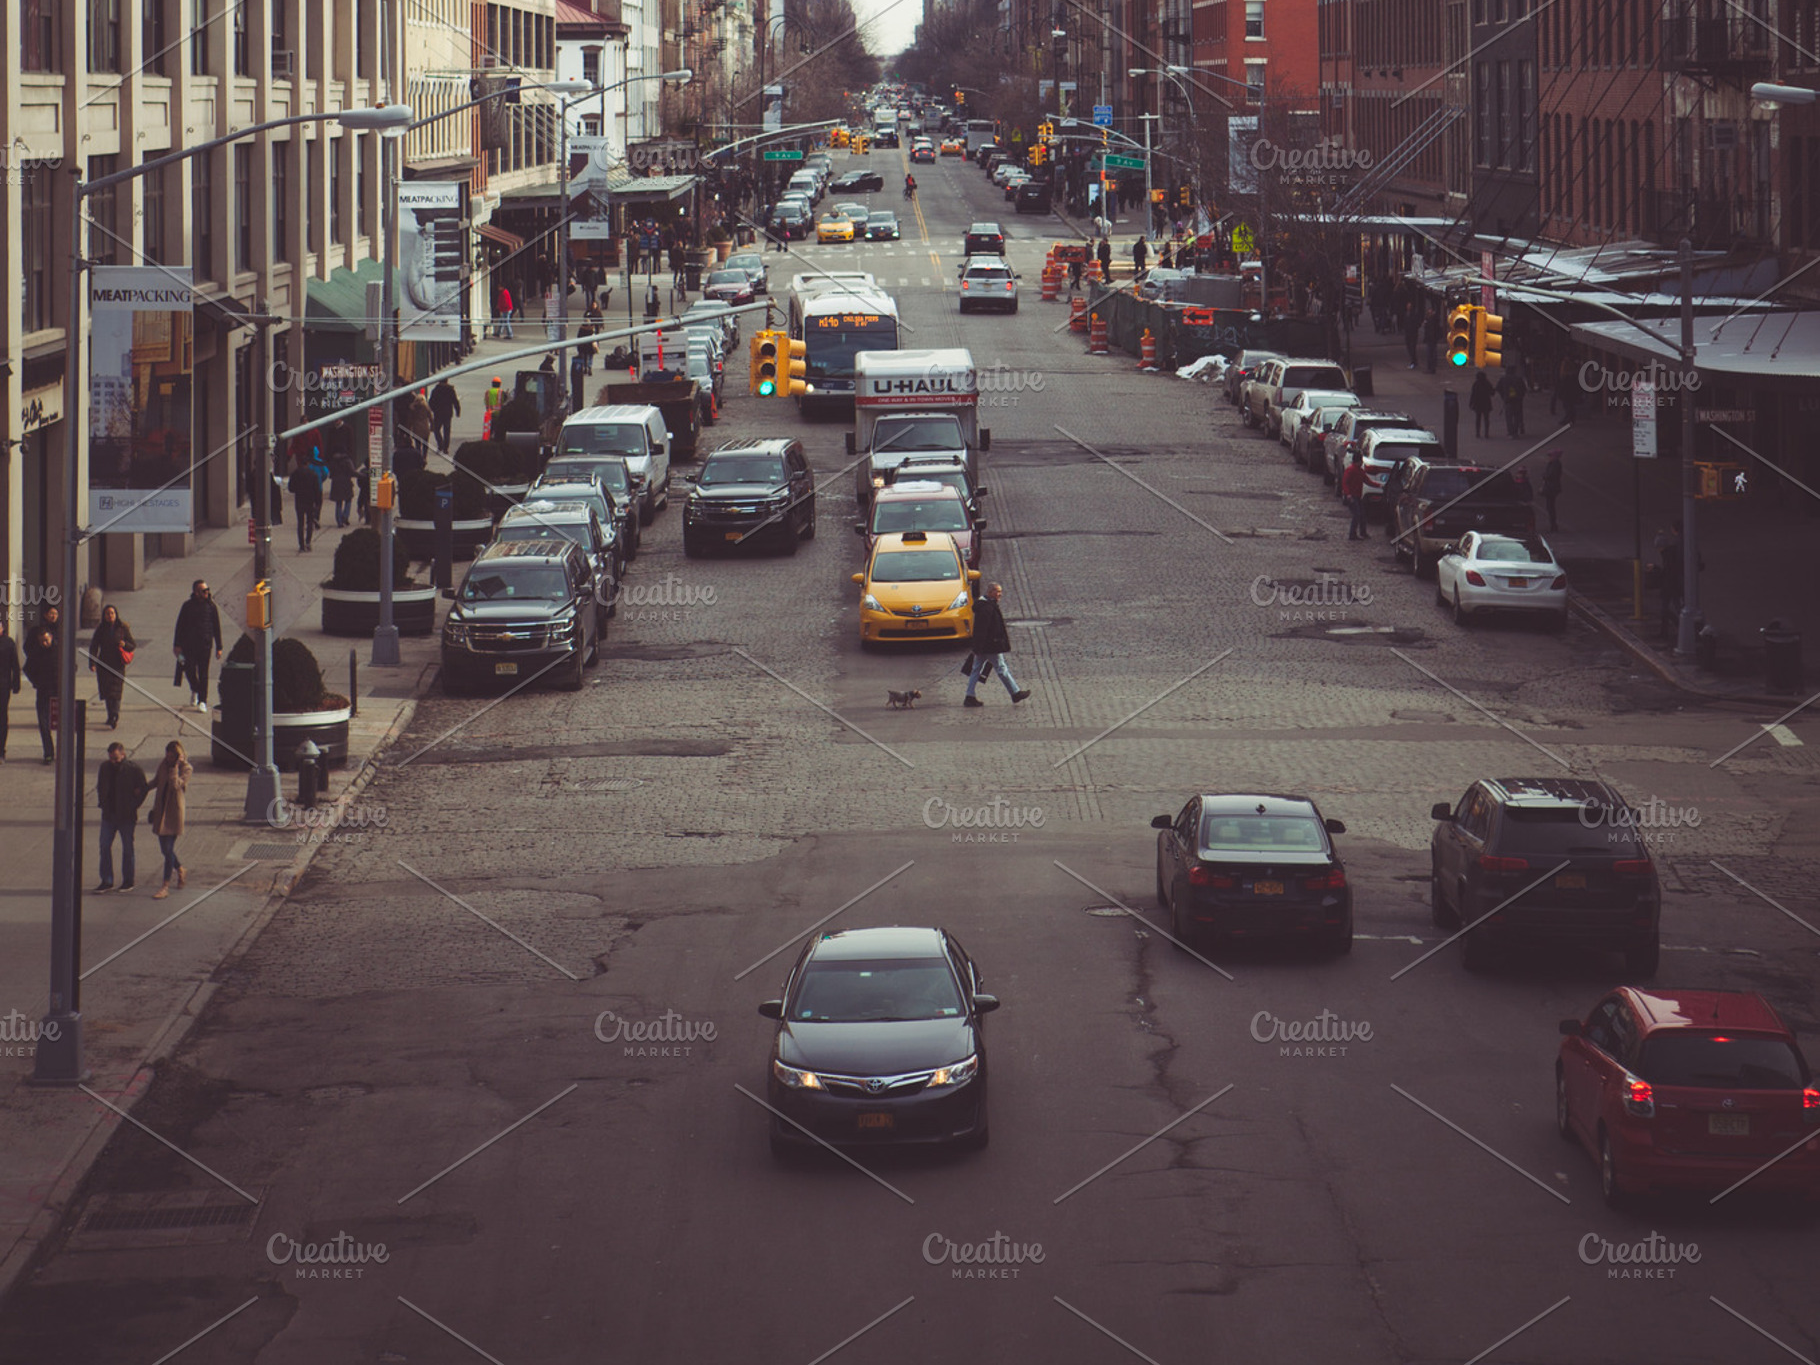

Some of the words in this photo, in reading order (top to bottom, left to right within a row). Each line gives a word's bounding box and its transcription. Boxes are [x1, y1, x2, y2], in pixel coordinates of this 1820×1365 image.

[399, 195, 458, 204] MEATPACKING
[93, 289, 191, 303] MEATPACKING
[818, 316, 839, 328] M14D
[322, 366, 368, 378] WASHINGTON
[369, 366, 379, 377] ST
[874, 378, 957, 394] U-HAUL
[1698, 409, 1745, 422] WASHINGTON
[1746, 409, 1756, 422] ST
